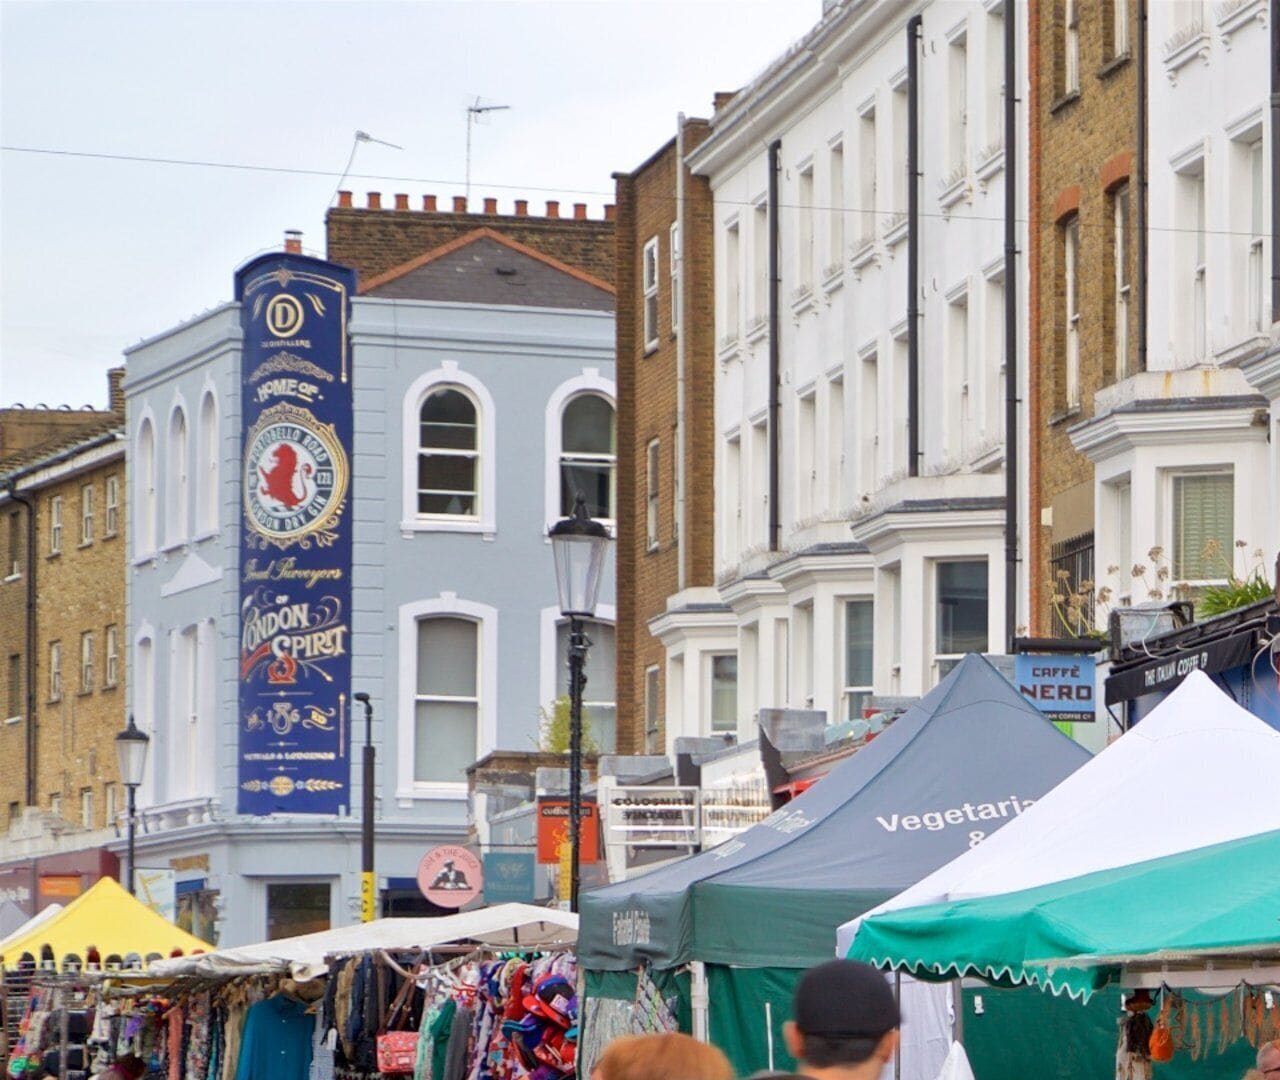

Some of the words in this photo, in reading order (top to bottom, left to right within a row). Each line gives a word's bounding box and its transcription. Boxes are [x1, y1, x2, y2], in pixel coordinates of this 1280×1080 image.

[257, 378, 298, 402] HOME
[298, 381, 320, 396] OF
[302, 435, 328, 462] ROAD
[285, 516, 307, 531] DRY
[307, 495, 328, 517] GIN
[271, 624, 348, 659] SPIRIT
[1032, 664, 1080, 678] CAFFÈ
[1145, 669, 1156, 687] THE
[1019, 684, 1092, 700] NERO
